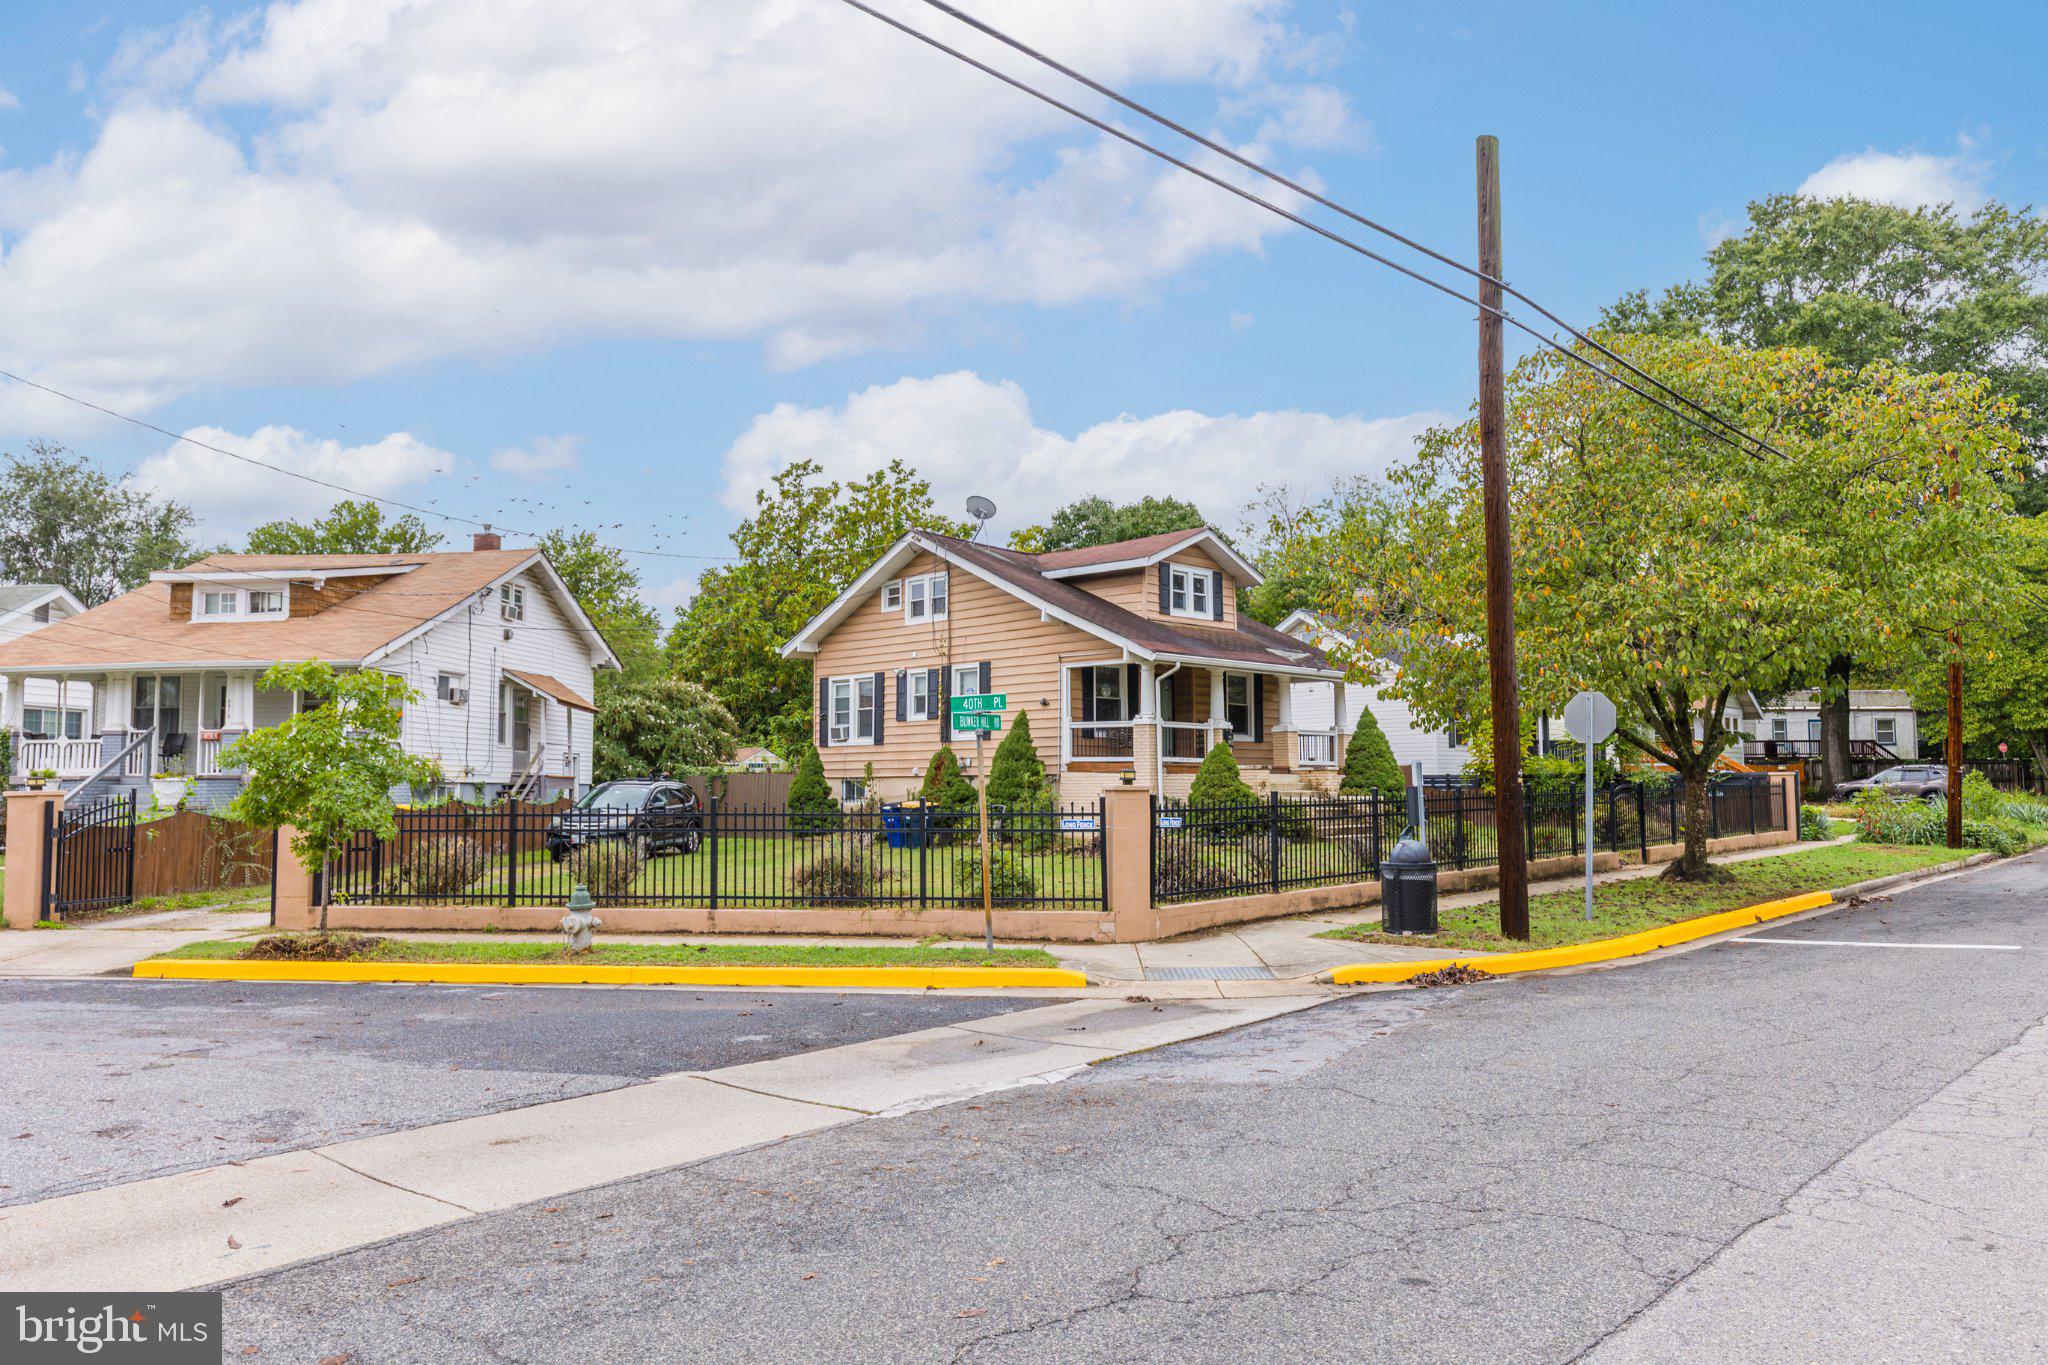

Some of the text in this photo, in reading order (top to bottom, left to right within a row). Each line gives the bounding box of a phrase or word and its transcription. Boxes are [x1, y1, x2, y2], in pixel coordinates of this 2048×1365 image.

[963, 697, 1003, 710] 40TH PL
[960, 716, 979, 728] BUNKER
[981, 716, 990, 728] HILL
